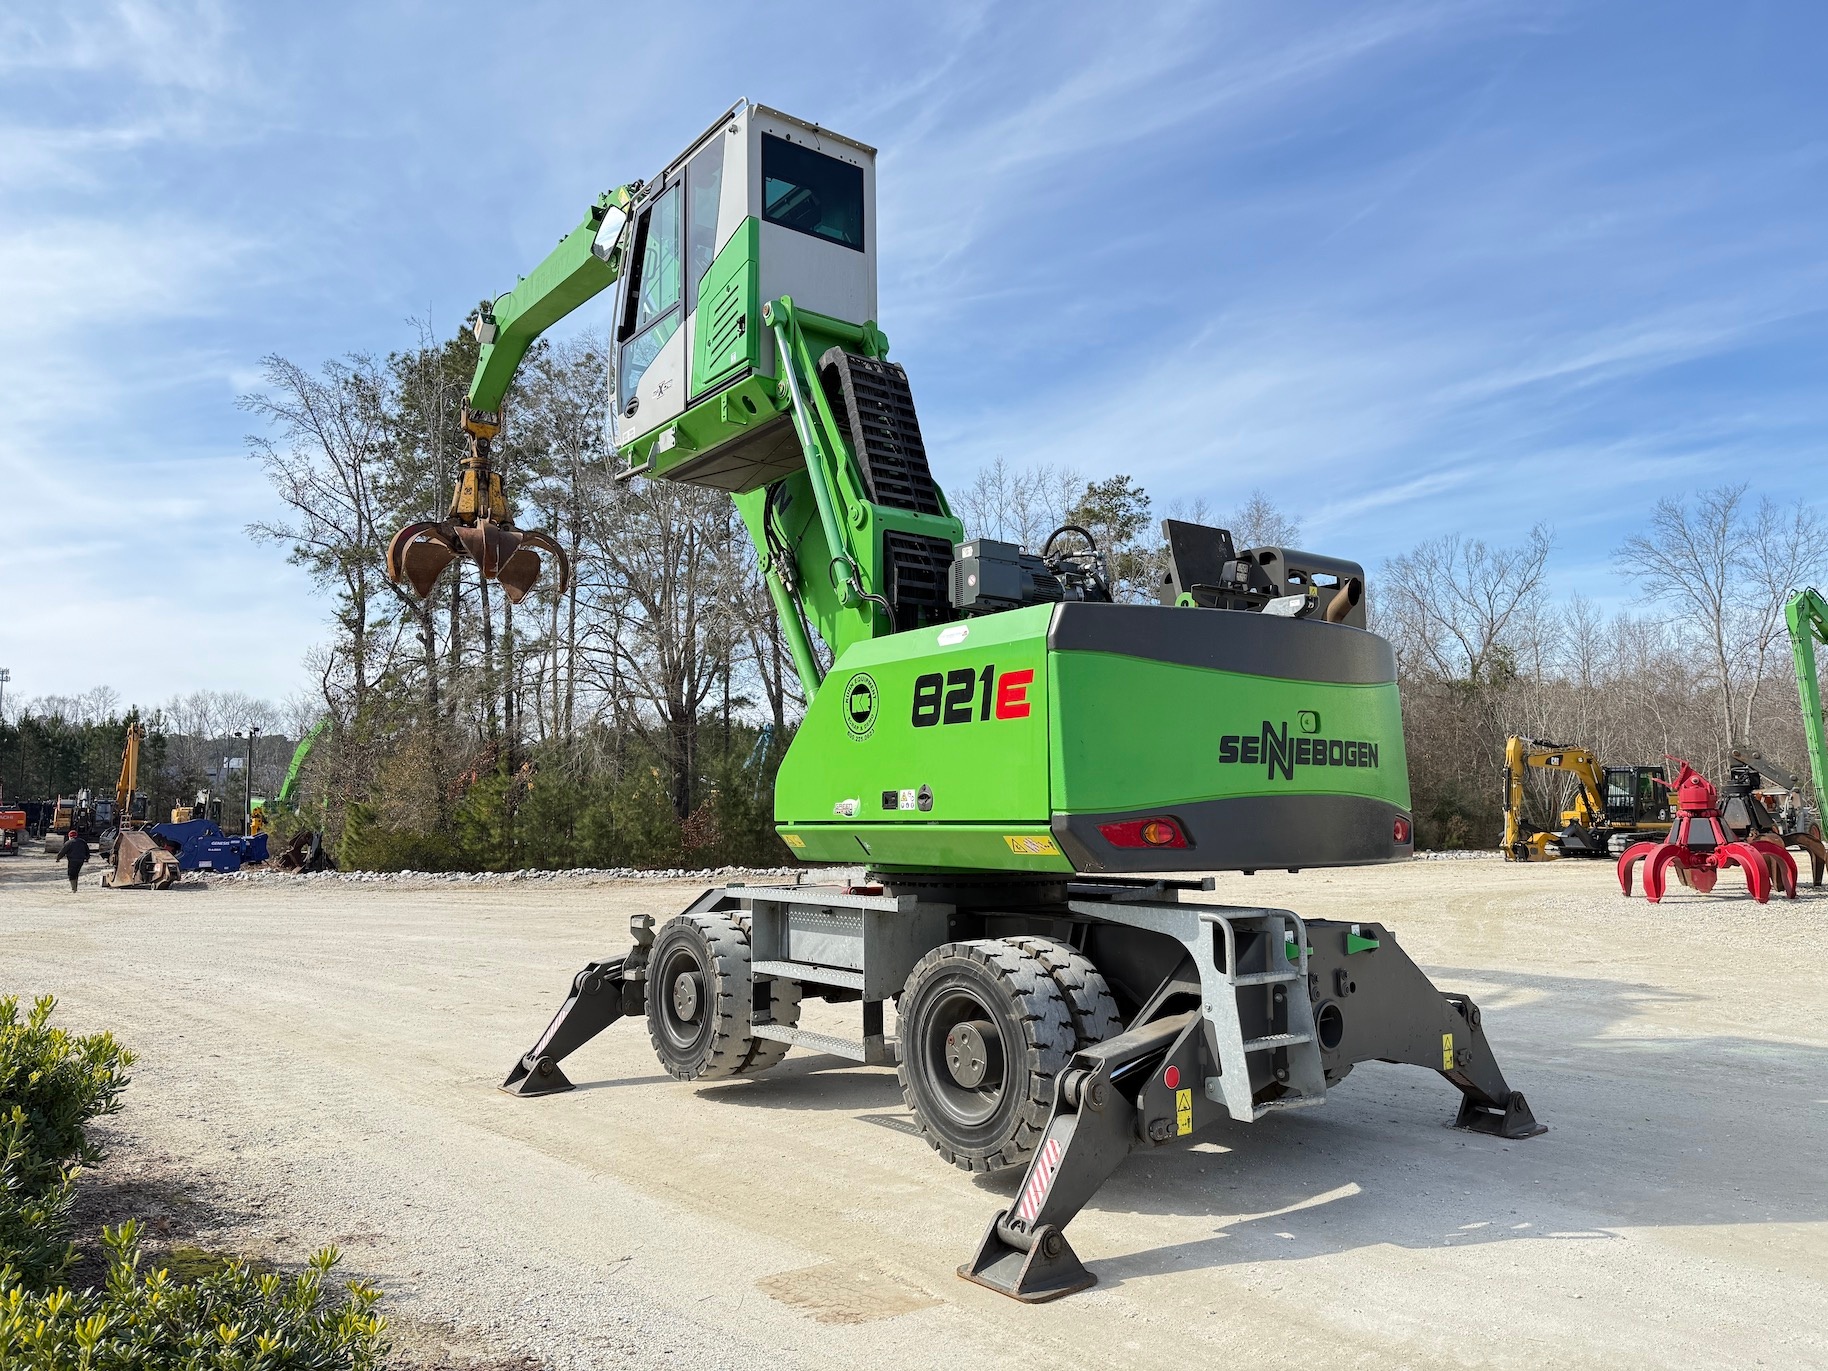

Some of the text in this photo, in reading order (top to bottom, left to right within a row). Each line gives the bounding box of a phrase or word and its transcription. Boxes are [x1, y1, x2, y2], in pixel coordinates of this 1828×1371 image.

[854, 676, 877, 699] EQUIPMENT
[911, 664, 1034, 728] 821E
[1218, 720, 1379, 781] SENNEBOGEN
